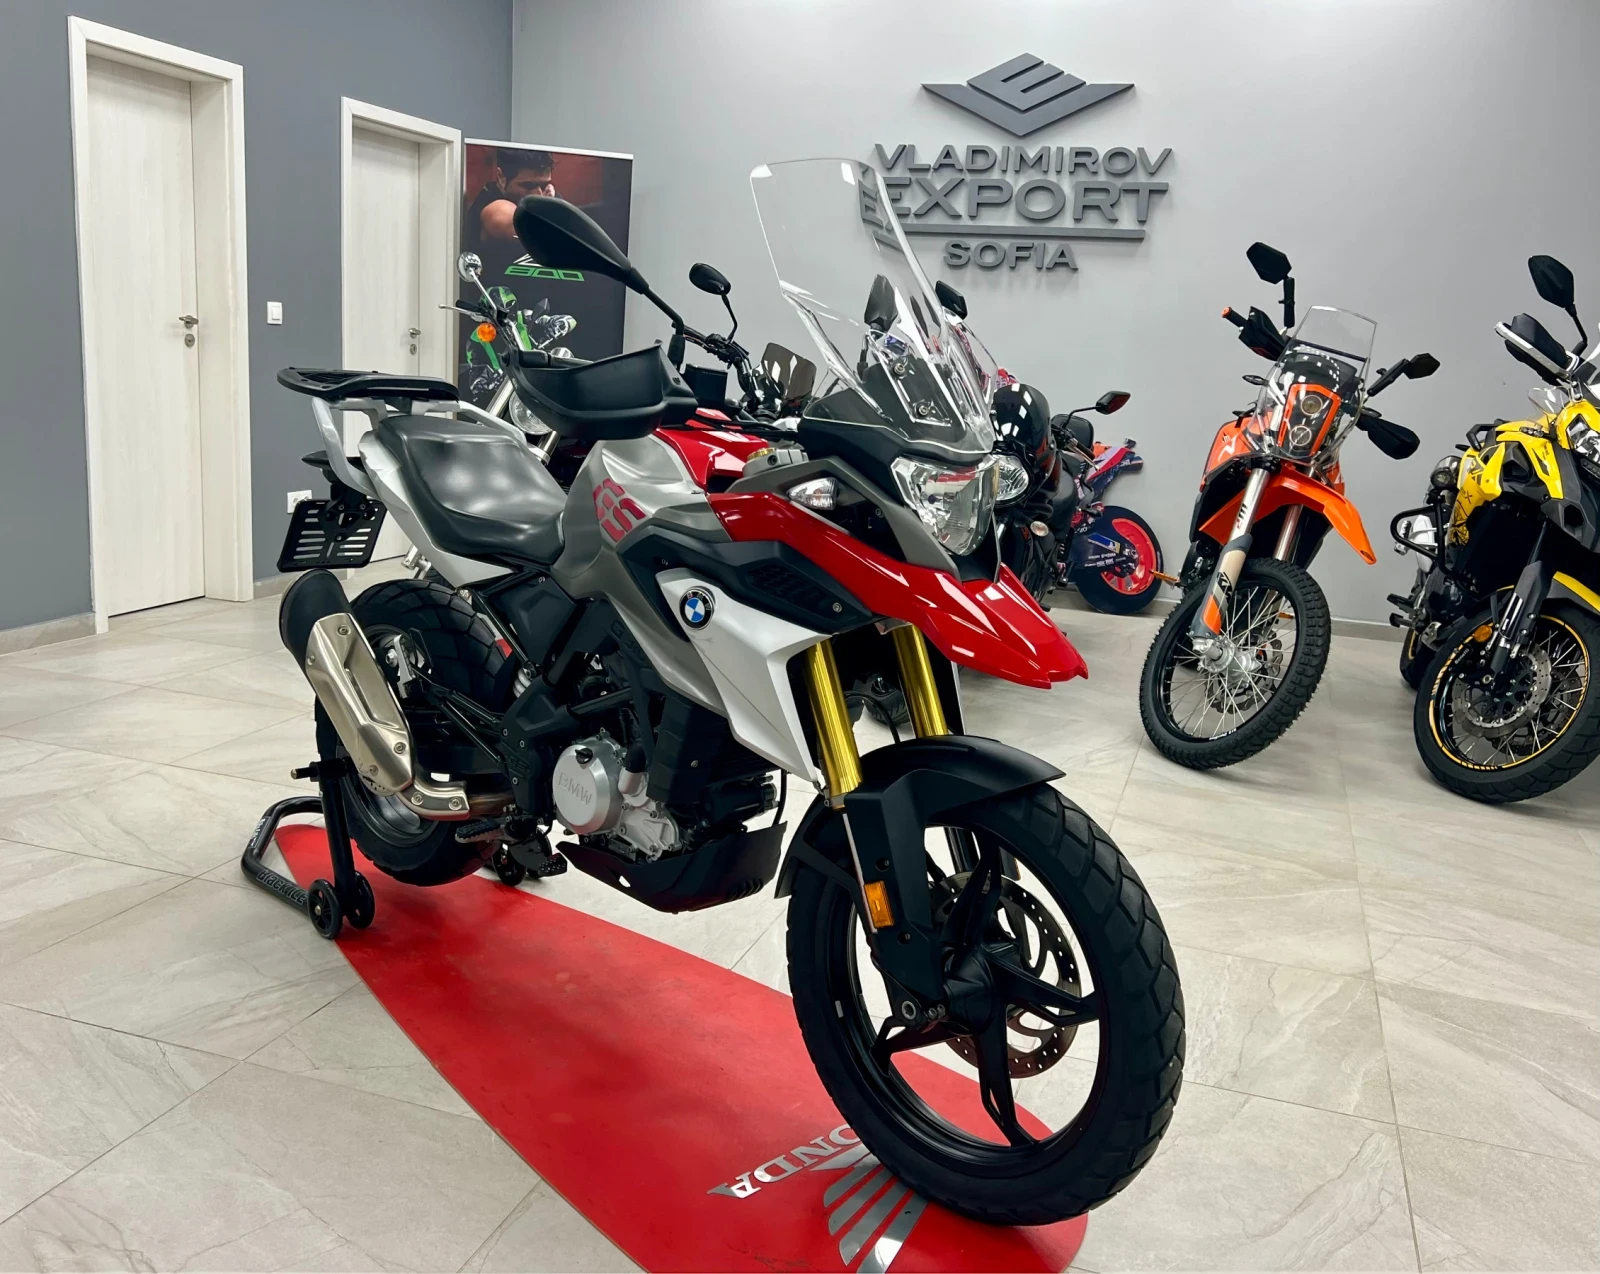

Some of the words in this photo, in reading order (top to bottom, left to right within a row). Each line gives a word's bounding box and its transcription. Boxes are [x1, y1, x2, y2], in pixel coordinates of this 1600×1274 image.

[874, 143, 1173, 175] VLADIMIROV
[874, 176, 1169, 223] EXPORT
[943, 240, 1079, 270] SOFIA
[504, 265, 585, 282] 800
[557, 772, 593, 806] BMW
[706, 1123, 862, 1199] ONDA
